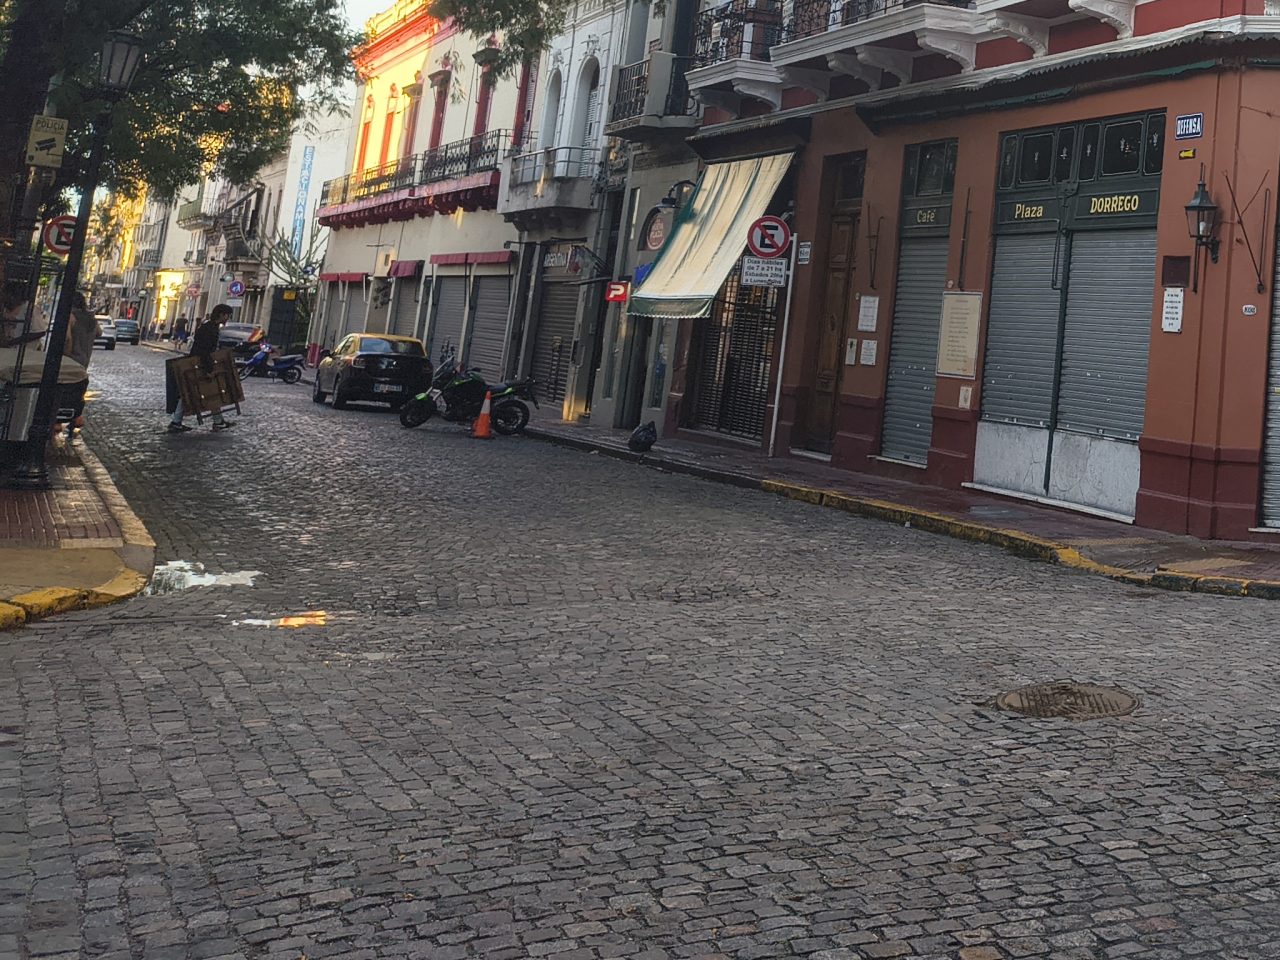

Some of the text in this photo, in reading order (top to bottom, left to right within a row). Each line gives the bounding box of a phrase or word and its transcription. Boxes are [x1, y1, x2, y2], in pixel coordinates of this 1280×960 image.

[1176, 117, 1201, 136] DEFENSA
[1014, 195, 1139, 219] Plaza DORREGO
